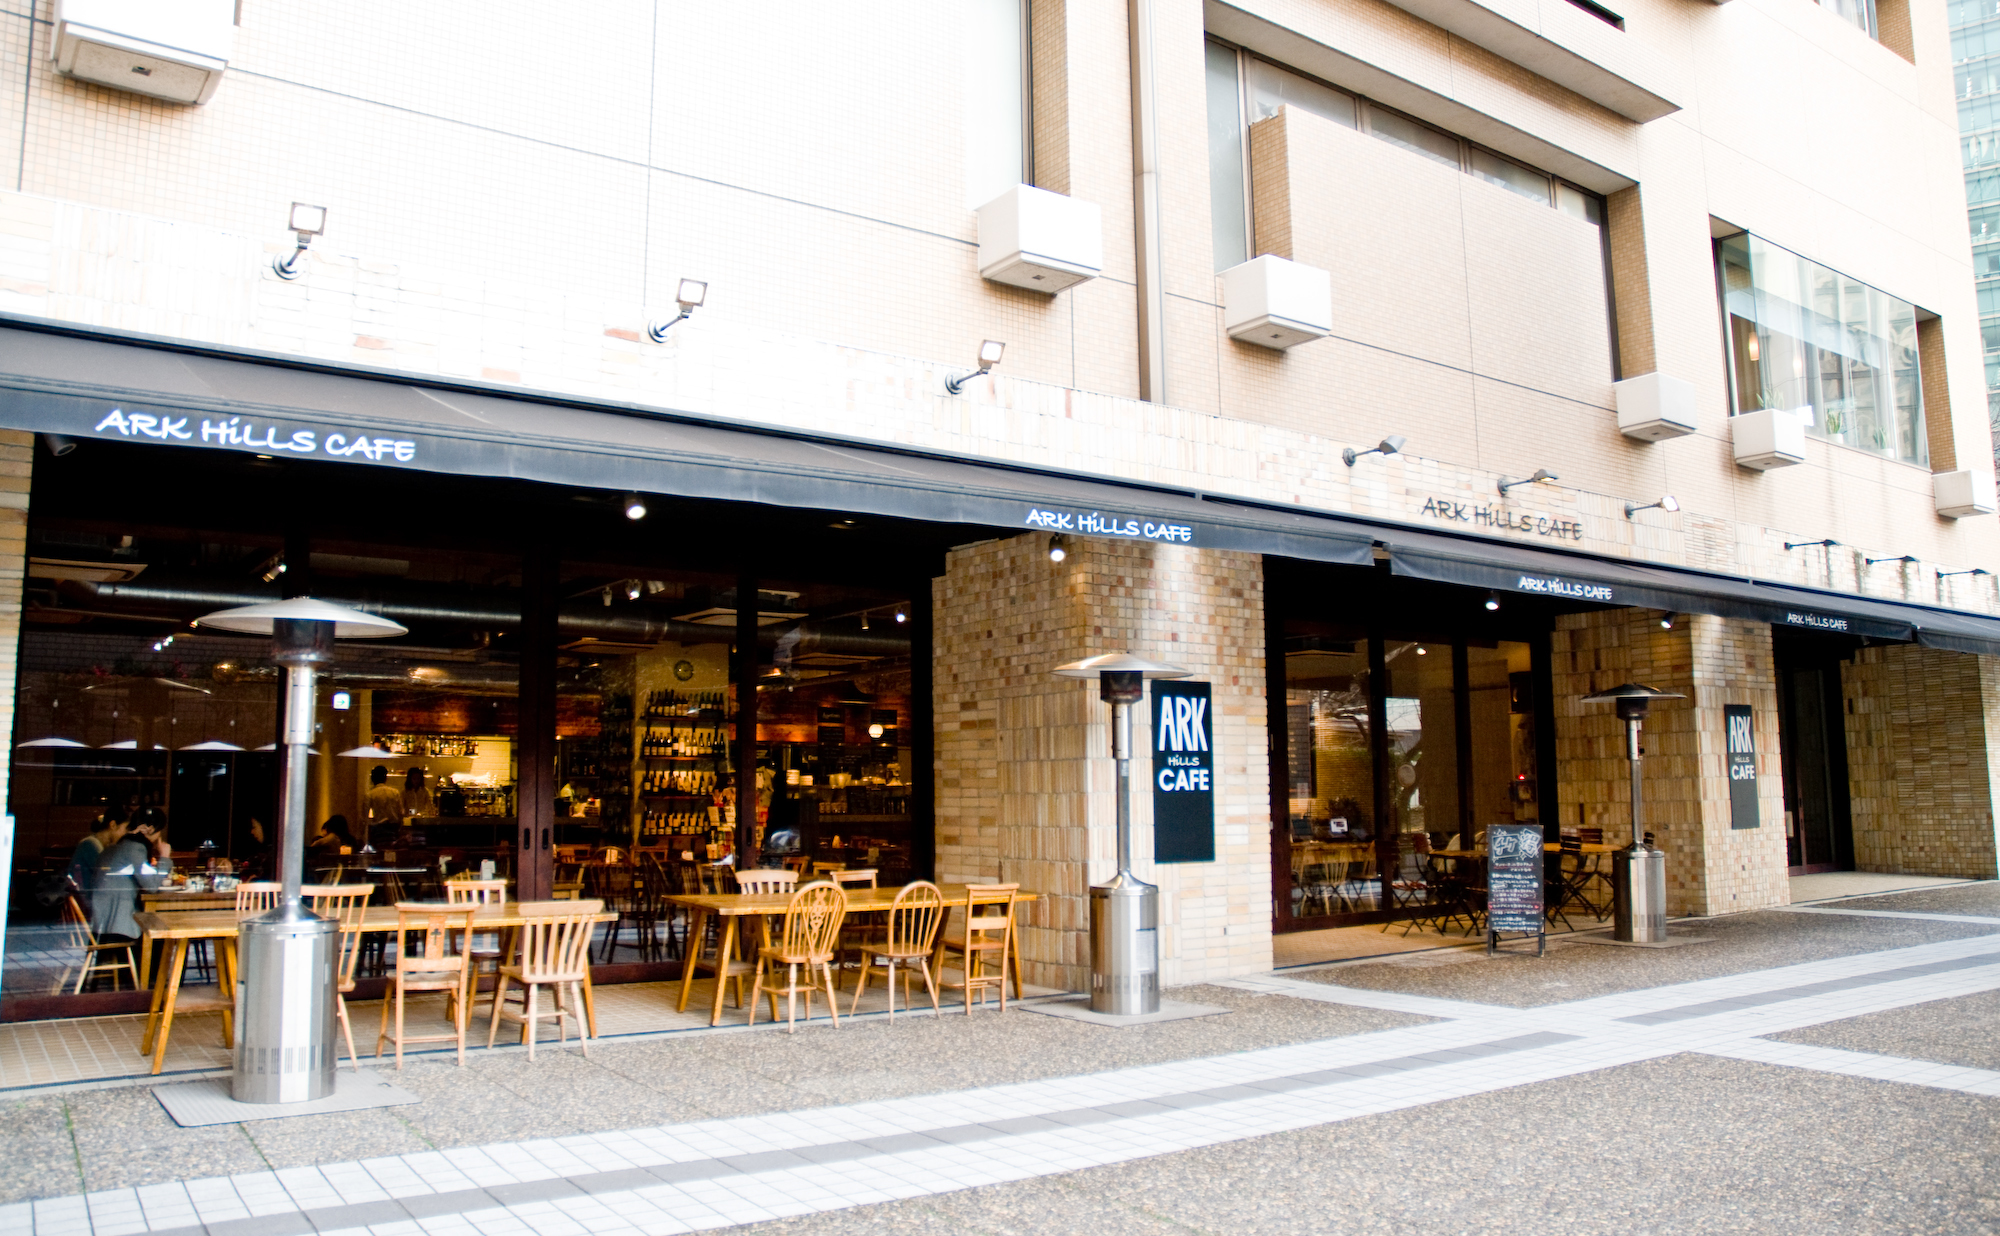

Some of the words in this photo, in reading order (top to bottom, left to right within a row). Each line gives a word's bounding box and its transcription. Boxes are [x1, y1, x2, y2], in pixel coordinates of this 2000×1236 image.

[95, 409, 192, 440] ARK
[325, 434, 416, 461] CAFE
[1026, 508, 1074, 529] ARK
[1144, 522, 1192, 542] CAFE
[1421, 497, 1470, 521] ARK
[1538, 517, 1582, 540] CAFE
[1518, 576, 1547, 592] ARK
[1584, 585, 1612, 600] CAFE
[1787, 612, 1804, 624] ARK
[1829, 618, 1848, 630] CAFE
[1159, 696, 1208, 751] ARK
[1729, 715, 1753, 753] ARK
[1158, 768, 1209, 791] CAFE
[1731, 764, 1755, 780] CAFE
